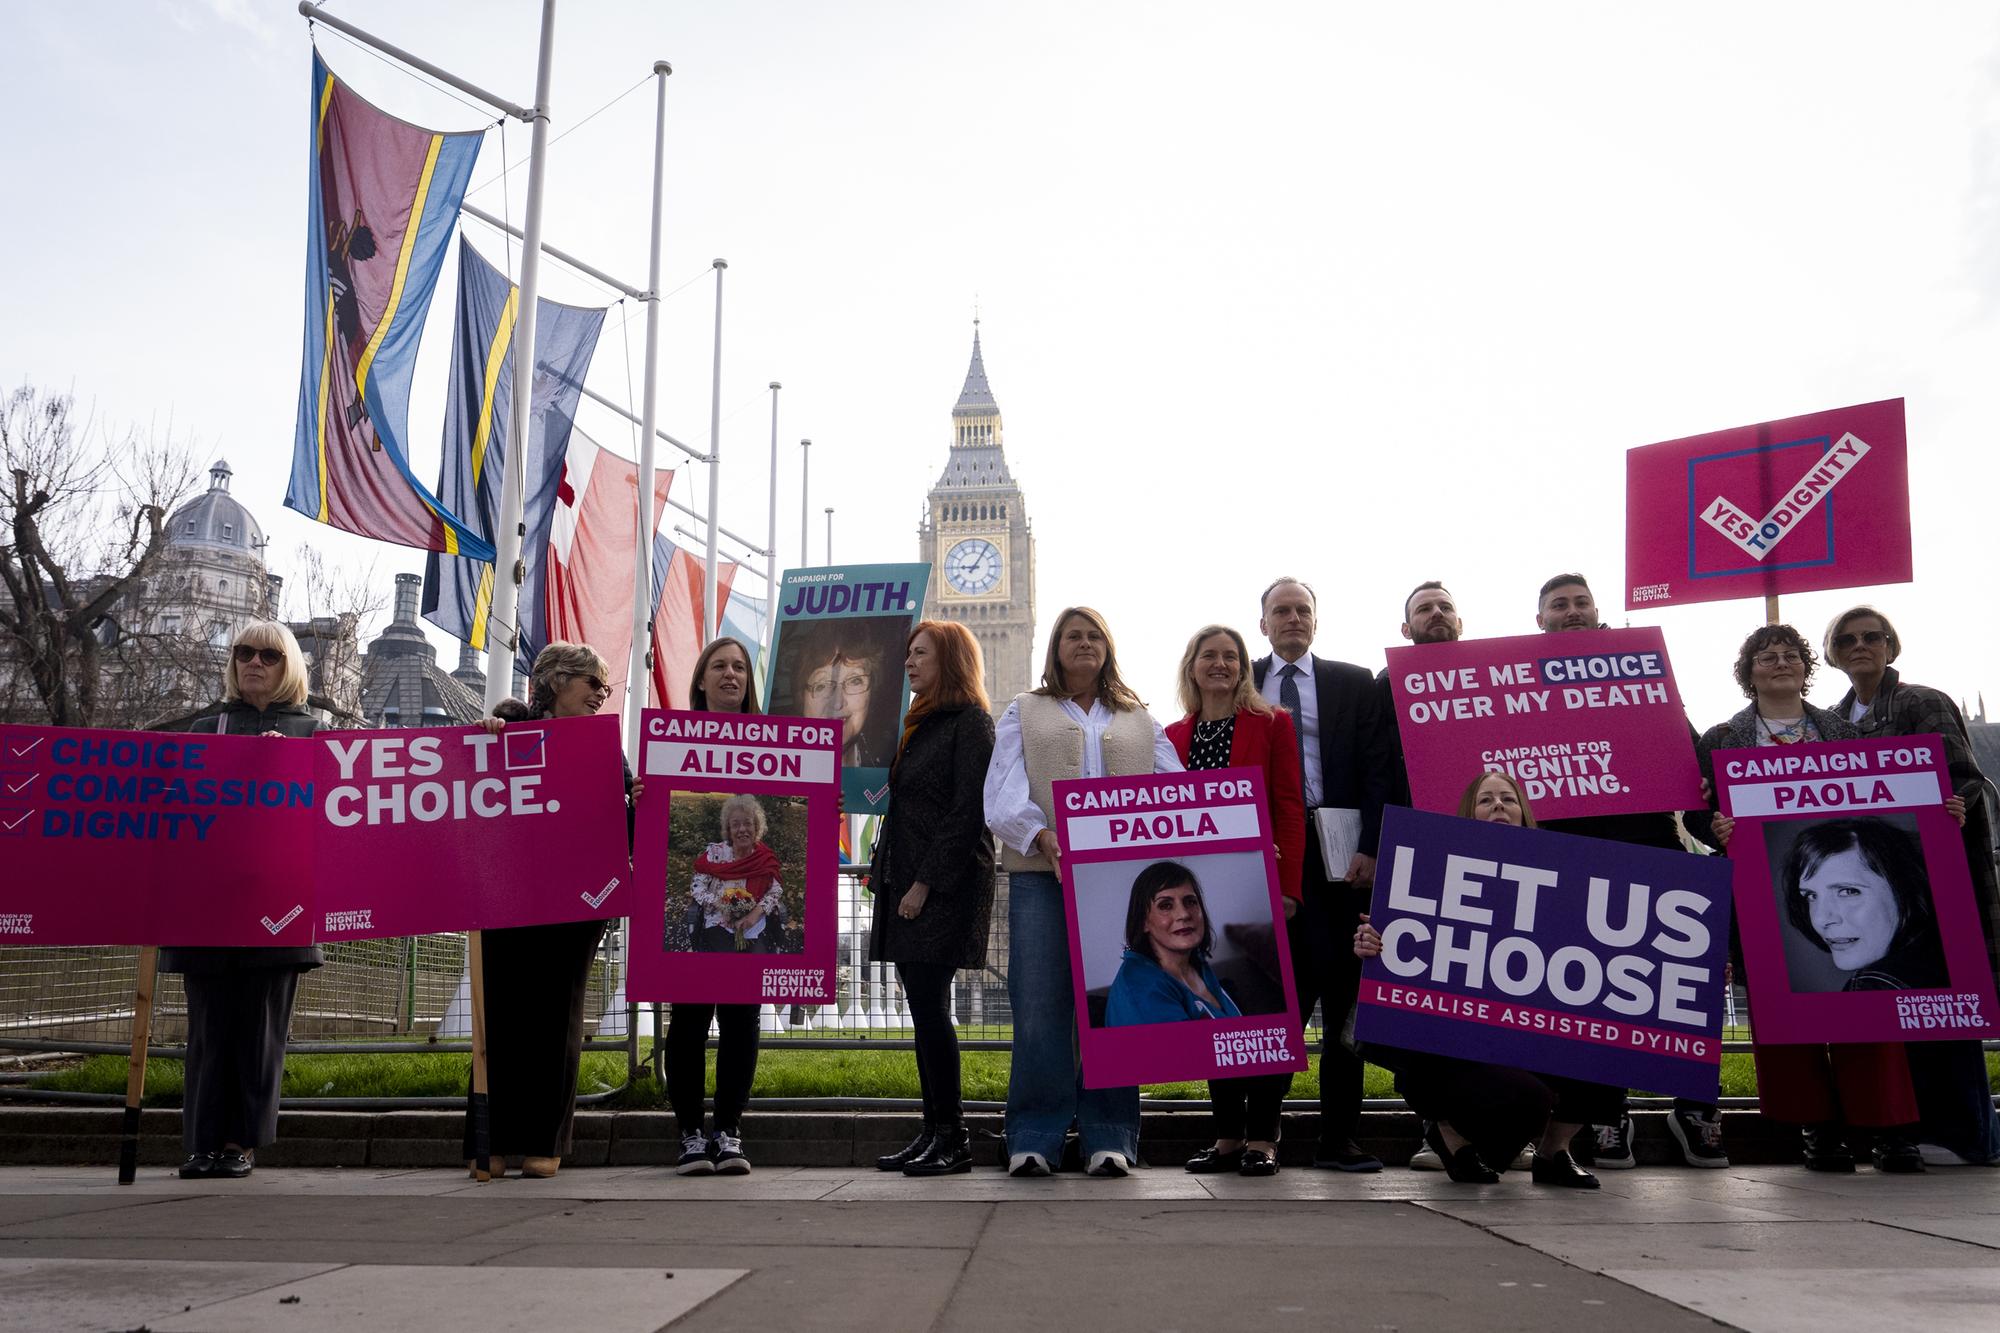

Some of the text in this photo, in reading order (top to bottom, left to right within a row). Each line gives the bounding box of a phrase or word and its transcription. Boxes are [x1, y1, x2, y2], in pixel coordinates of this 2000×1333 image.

[1711, 503, 1754, 540] YES
[788, 573, 844, 584] CAMPAIGN FOR
[1633, 587, 1669, 597] DIGNITY
[783, 581, 916, 616] JUDITH.
[1404, 653, 1662, 695] GIVE ME CHOICE
[1409, 682, 1669, 724] OVER MY DEATH
[649, 717, 834, 745] CAMPAIGN FOR
[51, 737, 208, 770] CHOICE
[325, 736, 443, 780] YES
[680, 749, 801, 778] ALISON
[1481, 740, 1612, 762] CAMPAIGN FOR
[1726, 747, 1934, 779] CAMPAIGN FOR
[47, 773, 314, 808] COMPASSION
[324, 774, 561, 827] CHOICE.
[1065, 780, 1254, 811] CAMPAIGN FOR
[1524, 774, 1631, 801] DYING.
[1773, 780, 1895, 810] PAOLA
[42, 809, 217, 841] DIGNITY
[1108, 812, 1219, 842] PAOLA
[1388, 845, 1559, 932] LET
[1586, 877, 1712, 959] US
[0, 918, 32, 927] NITY
[325, 914, 371, 924] DIGNITY
[325, 921, 375, 932] IN DYING.
[762, 968, 806, 976] CAMPAIGN
[762, 975, 825, 987] DIGNITY
[1380, 918, 1711, 1028] CHOOSE
[762, 986, 828, 998] IN DYING.
[1896, 993, 1980, 1004] CAMPAIGN FOR
[1376, 986, 1707, 1057] LEGALISE ASSISTED DYING
[1897, 1001, 1980, 1017] DIGNITY
[1899, 1014, 1991, 1030] IN DYING.
[1213, 1027, 1287, 1040] CAMPAIGN FOR
[1214, 1035, 1287, 1054] DIGNITY
[1216, 1048, 1296, 1067] IN DYING.
